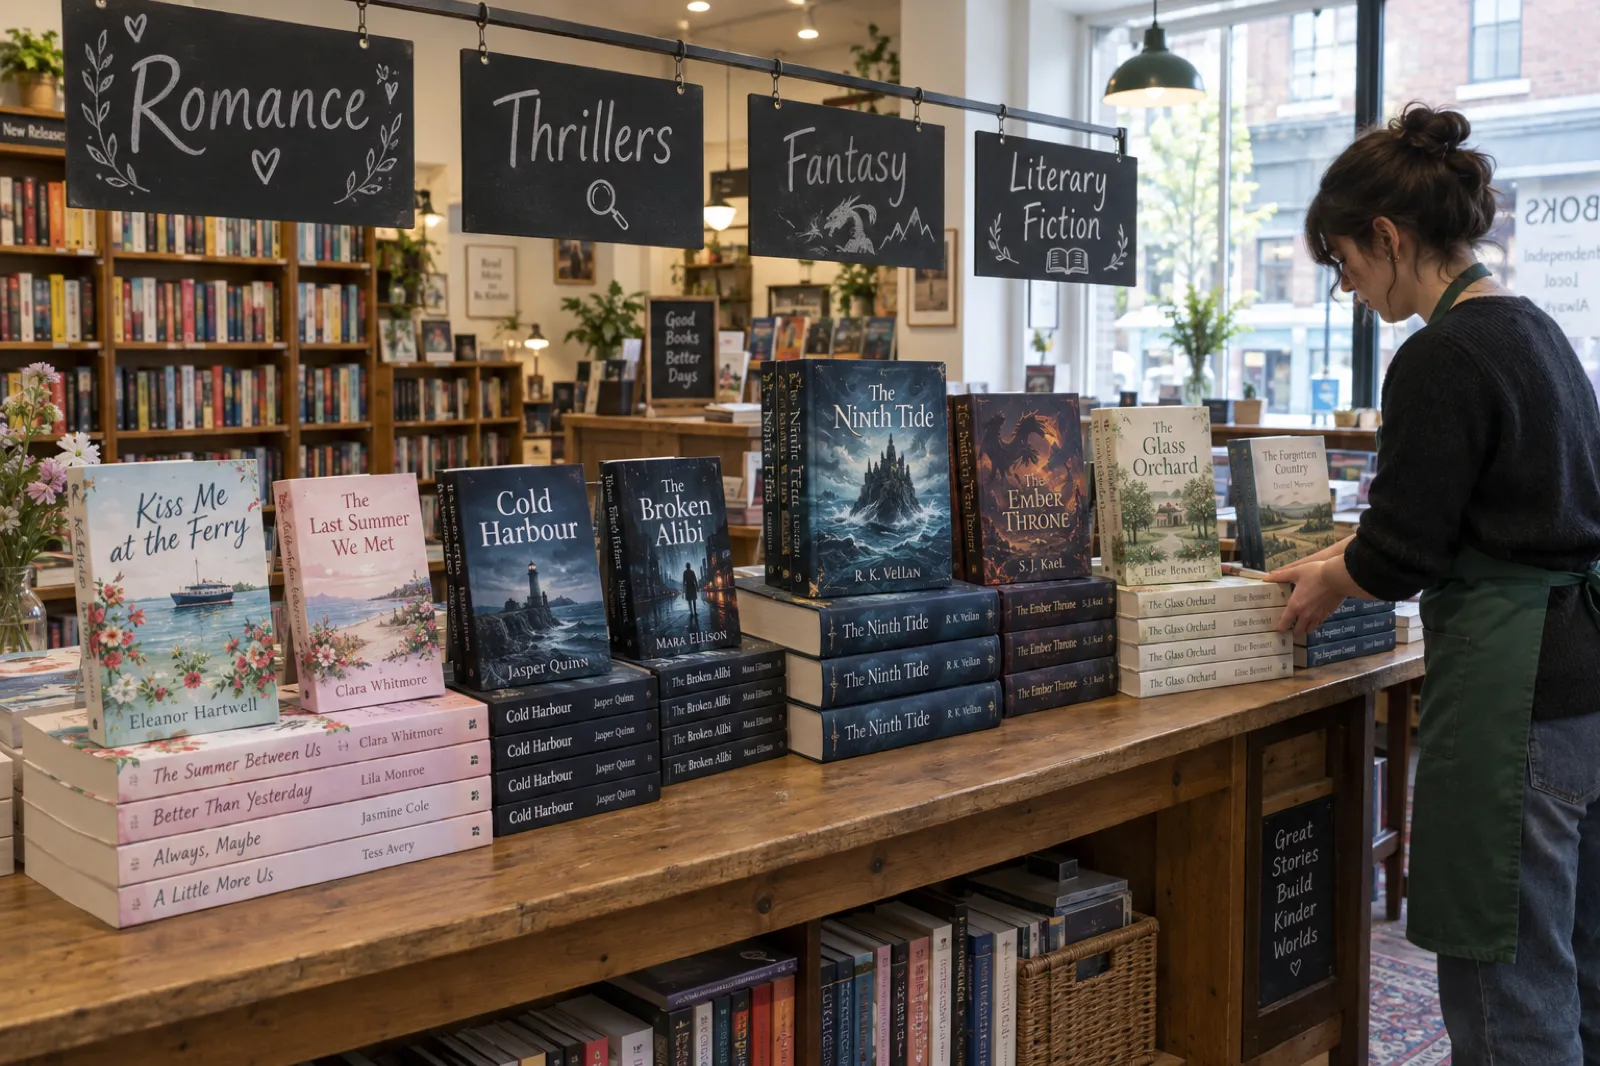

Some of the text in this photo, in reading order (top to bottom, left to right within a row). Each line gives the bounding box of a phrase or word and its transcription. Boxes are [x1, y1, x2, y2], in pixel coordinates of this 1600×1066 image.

[131, 54, 369, 155] Romance
[3, 121, 25, 138] New
[493, 89, 672, 168] Thrillers
[783, 127, 906, 207] Fantasy
[1010, 151, 1106, 211] Literary
[1024, 201, 1101, 241] Fiction
[665, 310, 696, 328] Good
[665, 330, 700, 346] Books
[665, 350, 701, 365] Better
[668, 367, 698, 389] Days
[868, 383, 896, 402] The
[833, 403, 934, 437] Ninth Tide
[1153, 421, 1173, 434] The
[1143, 436, 1186, 456] Glass
[1262, 450, 1278, 462] The
[1132, 455, 1199, 476] Orchard
[1275, 463, 1308, 476] Country
[661, 478, 685, 493] The
[1024, 472, 1045, 488] The
[136, 482, 229, 528] Kiss Me
[341, 492, 370, 509] The
[496, 487, 553, 516] Cold
[638, 494, 712, 521] Broken
[309, 512, 410, 535] Last Summer
[479, 517, 579, 547] Harbour
[655, 520, 705, 547] Alibi
[109, 515, 250, 563] at the Ferry
[331, 535, 395, 557] We Met
[855, 569, 867, 582] R.
[869, 568, 881, 581] K.
[1019, 560, 1028, 573] S.
[1030, 559, 1038, 574] J.
[1144, 565, 1167, 577] Elise
[1148, 594, 1216, 610] The Glass Orchard
[842, 613, 929, 639] The Ninth Tide
[1148, 620, 1216, 636] The Glass Orchard
[1149, 645, 1216, 662] The Glass Orchard
[507, 663, 546, 681] Jasper
[686, 671, 712, 685] Broken
[843, 660, 930, 688] The Ninth Tide
[1150, 670, 1217, 689] The Glass Orchard
[335, 674, 428, 698] Clara Whitmore
[593, 693, 634, 709] Jasper Quinn
[686, 699, 713, 714] Broken
[129, 696, 258, 730] Eleanor Hartwell
[506, 703, 572, 724] Cold Harbour
[594, 730, 614, 742] Jasper
[687, 728, 713, 742] Broken
[844, 710, 930, 741] The Ninth Tide
[359, 726, 444, 749] Clara Whitmore
[507, 736, 573, 758] Cold Harbour
[153, 742, 322, 785] The Summer Between Us
[595, 763, 615, 776] Jasper
[688, 757, 714, 771] Broken
[360, 766, 425, 786] Lila Monroe
[508, 769, 573, 793] Cold Harbour
[153, 783, 313, 827] Better Than Yesterday
[596, 793, 616, 806] Jasper
[361, 799, 430, 826] Jasmine Cole
[509, 801, 574, 824] Cold Harbour
[1275, 820, 1314, 851] Great
[153, 831, 261, 868] Always, Maybe
[361, 840, 416, 861] Tess Avery
[1272, 848, 1319, 877] Stories
[153, 867, 274, 909] A Little More Us
[1276, 872, 1313, 904] Build
[1274, 902, 1317, 933] Kinder
[1273, 926, 1318, 960] Worlds
